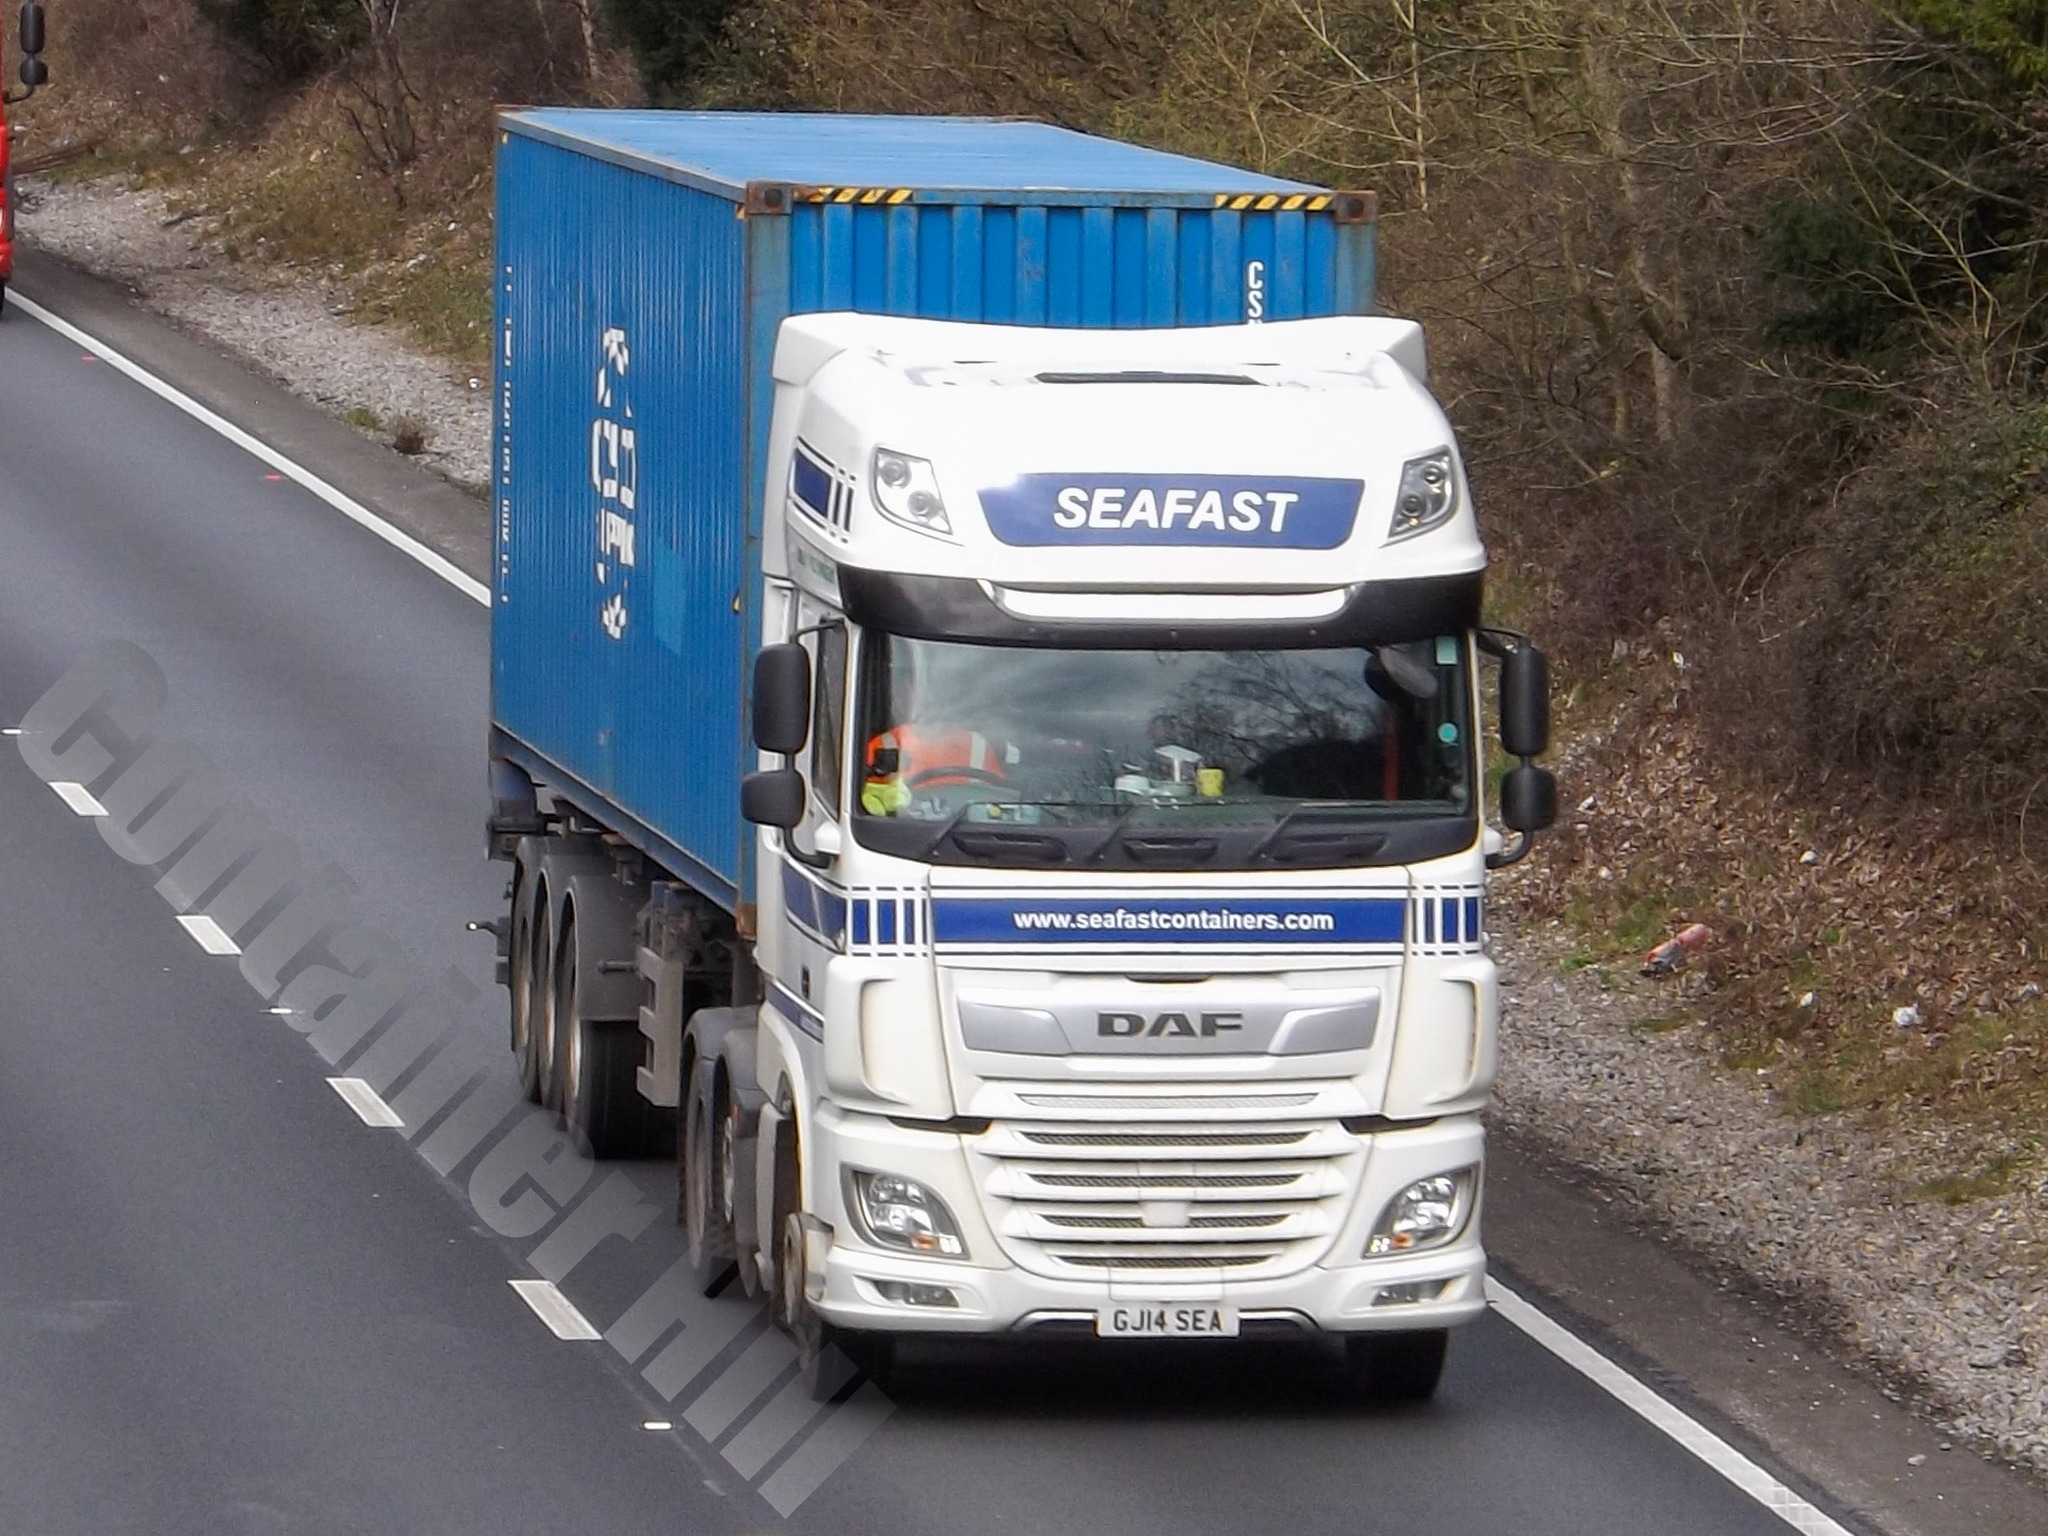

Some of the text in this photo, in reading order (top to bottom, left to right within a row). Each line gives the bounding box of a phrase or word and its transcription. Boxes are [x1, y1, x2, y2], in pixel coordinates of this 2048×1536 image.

[1053, 488, 1299, 532] SEAFAST
[1013, 908, 1334, 931] www.seafastcontainers.com
[1097, 1011, 1243, 1038] DAF
[1113, 1309, 1222, 1332] GJ14 SEA
